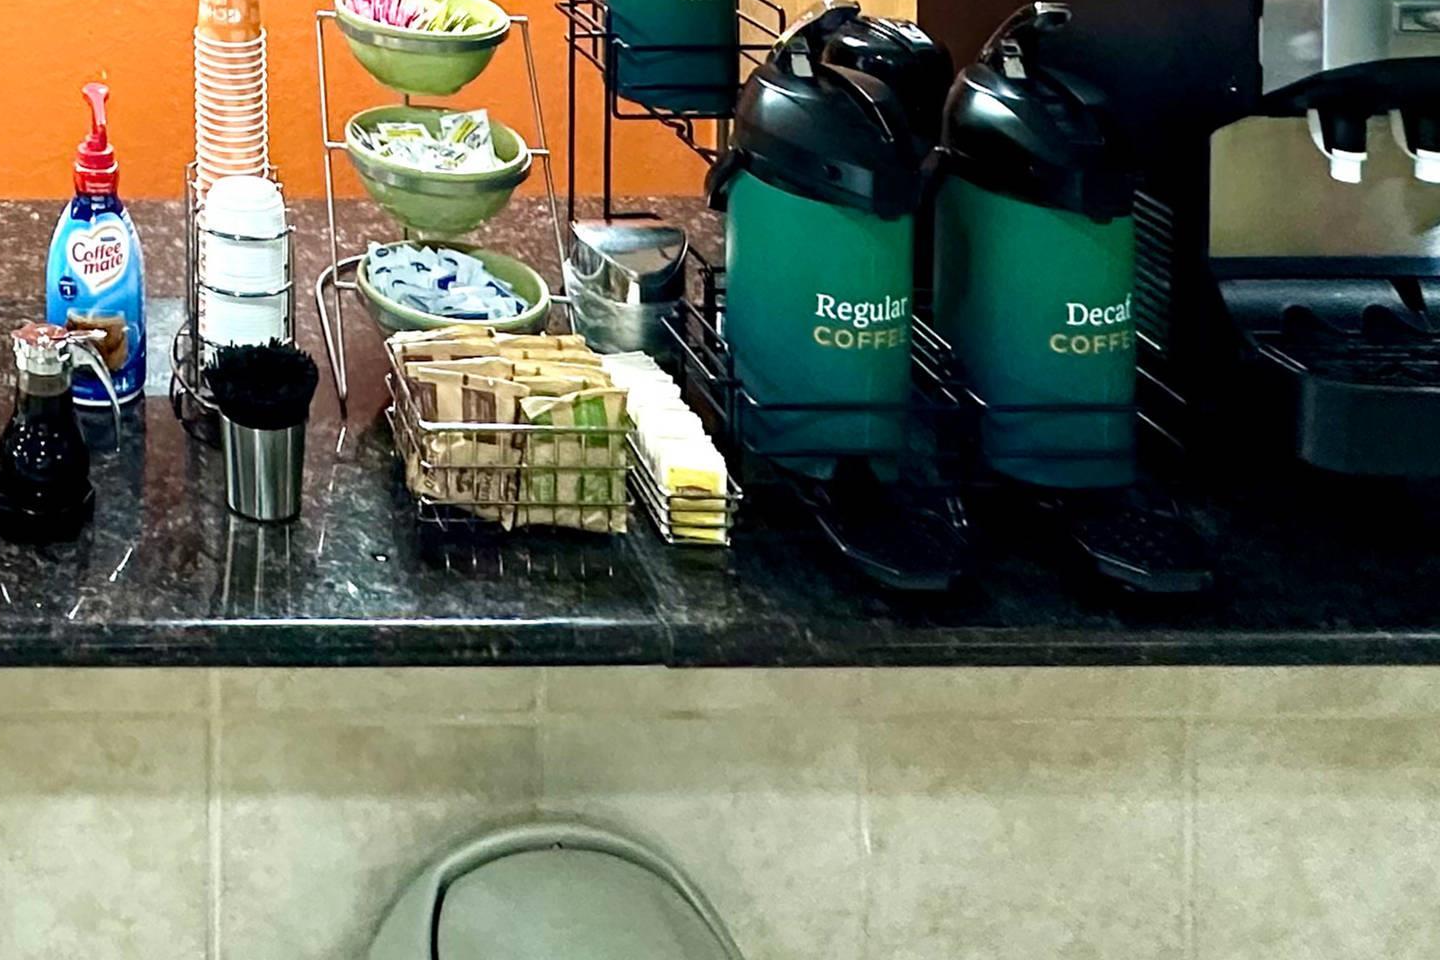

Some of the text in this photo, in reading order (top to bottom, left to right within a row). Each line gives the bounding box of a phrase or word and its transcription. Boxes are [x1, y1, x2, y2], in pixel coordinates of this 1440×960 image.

[72, 241, 122, 263] Coffee
[84, 253, 124, 275] mate
[815, 293, 908, 328] Regular
[1065, 292, 1132, 326] Decaf
